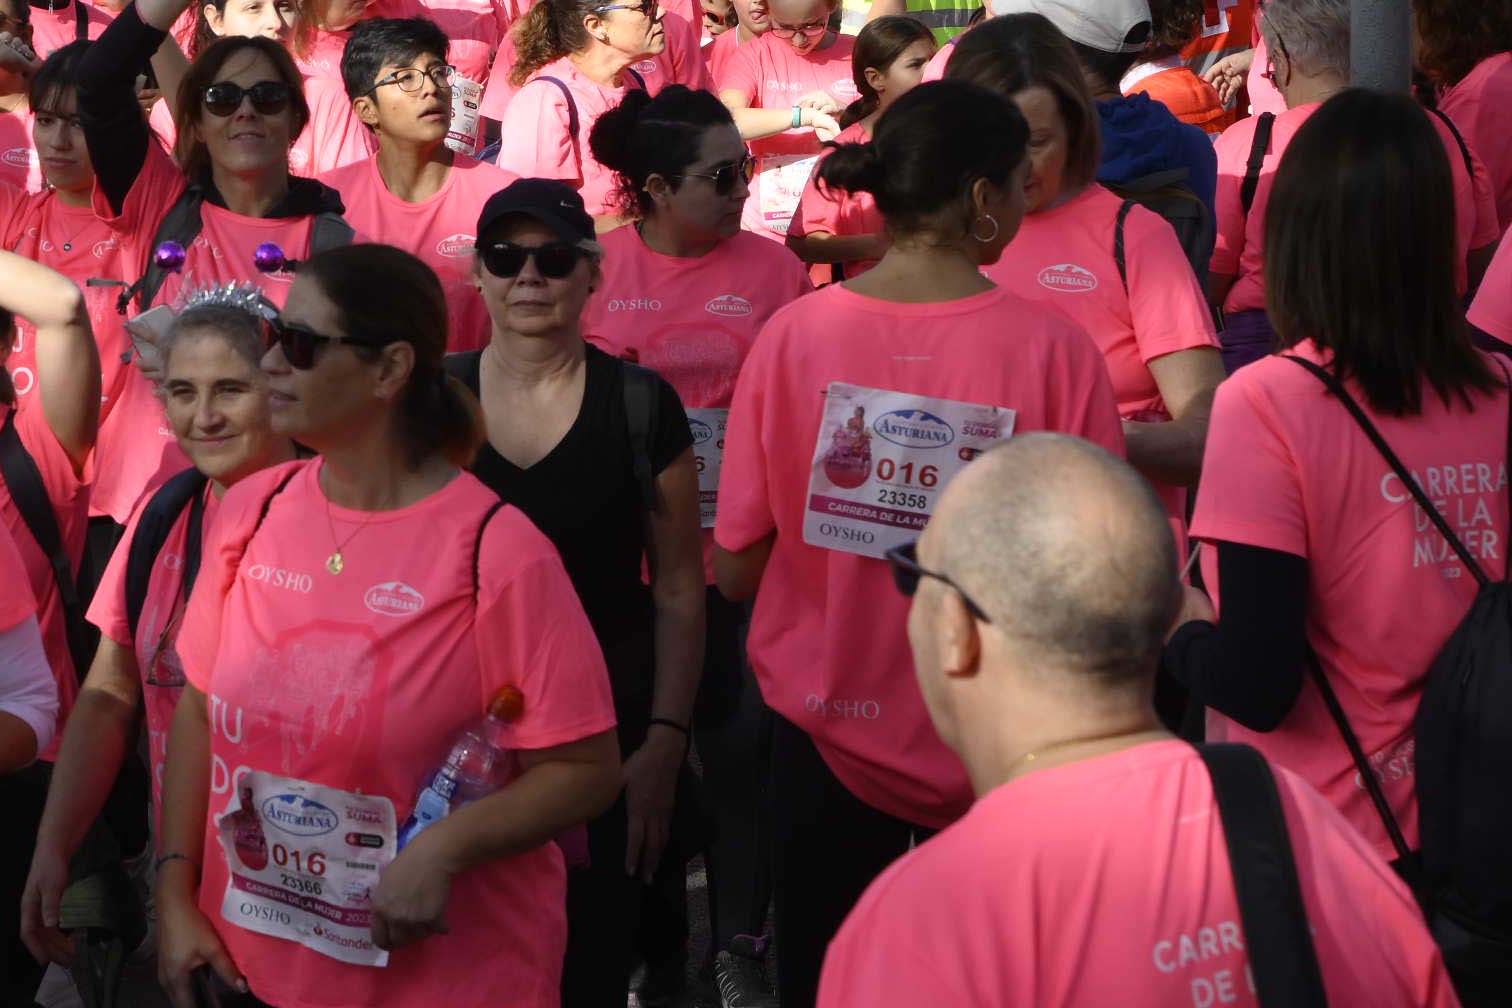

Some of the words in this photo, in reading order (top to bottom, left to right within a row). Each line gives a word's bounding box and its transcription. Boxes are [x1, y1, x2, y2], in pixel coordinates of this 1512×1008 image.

[607, 299, 662, 313] OYSHO
[879, 418, 948, 443] ASTURIANA
[875, 458, 939, 488] 016
[878, 489, 927, 509] 23358
[1458, 497, 1494, 527] LA
[827, 501, 877, 518] CARRERA
[879, 509, 894, 521] DE
[896, 512, 909, 525] LA
[819, 522, 875, 544] OYSHO
[248, 564, 313, 592] OYSHO
[211, 696, 244, 743] TU
[804, 693, 880, 720] OYSHO
[266, 803, 332, 829] ASTURIANA
[272, 844, 327, 876] 016
[280, 873, 323, 895] 23366
[240, 901, 291, 925] OYSHO
[1152, 920, 1243, 974] CARR
